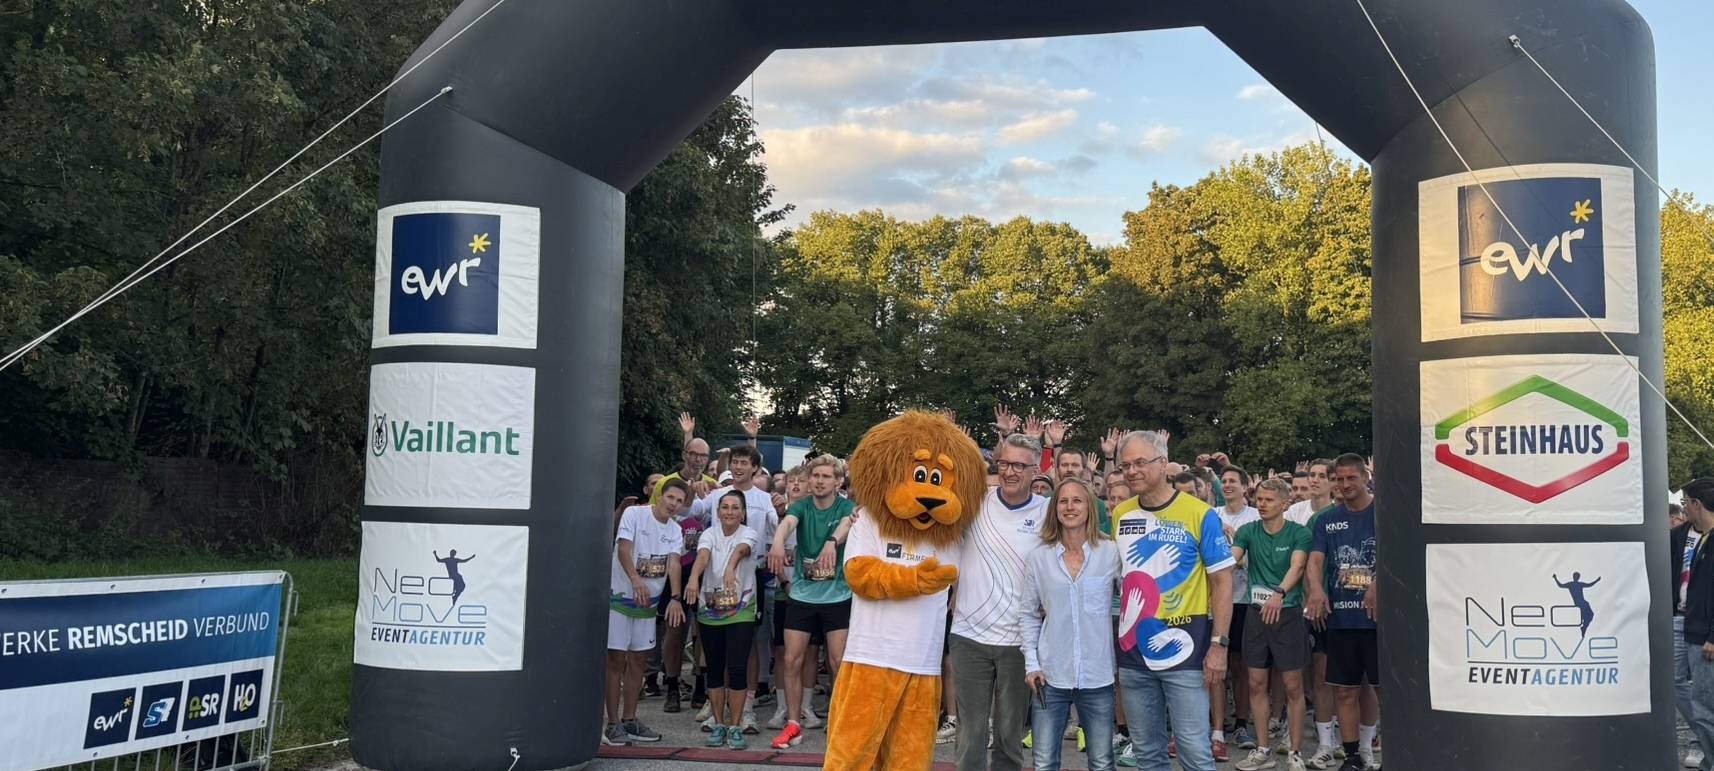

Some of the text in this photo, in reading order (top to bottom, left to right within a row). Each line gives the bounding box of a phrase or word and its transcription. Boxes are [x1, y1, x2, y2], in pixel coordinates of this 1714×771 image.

[1480, 228, 1585, 282] ewr
[401, 257, 481, 301] ewr
[391, 420, 520, 456] Vaillant
[1465, 424, 1604, 456] STEINHAUS
[1148, 533, 1157, 541] IM
[1160, 526, 1186, 536] STARK
[373, 567, 455, 596] Neo
[371, 595, 487, 624] Move
[1167, 615, 1192, 626] 2026
[1465, 597, 1584, 627] Neo
[0, 612, 270, 656] ERKE REMSCHEID VERBUND
[371, 627, 486, 646] EVENTAGENTUR
[1466, 628, 1618, 660] Move
[1468, 667, 1618, 685] EVENTAGENTUR
[93, 708, 128, 732] ewr
